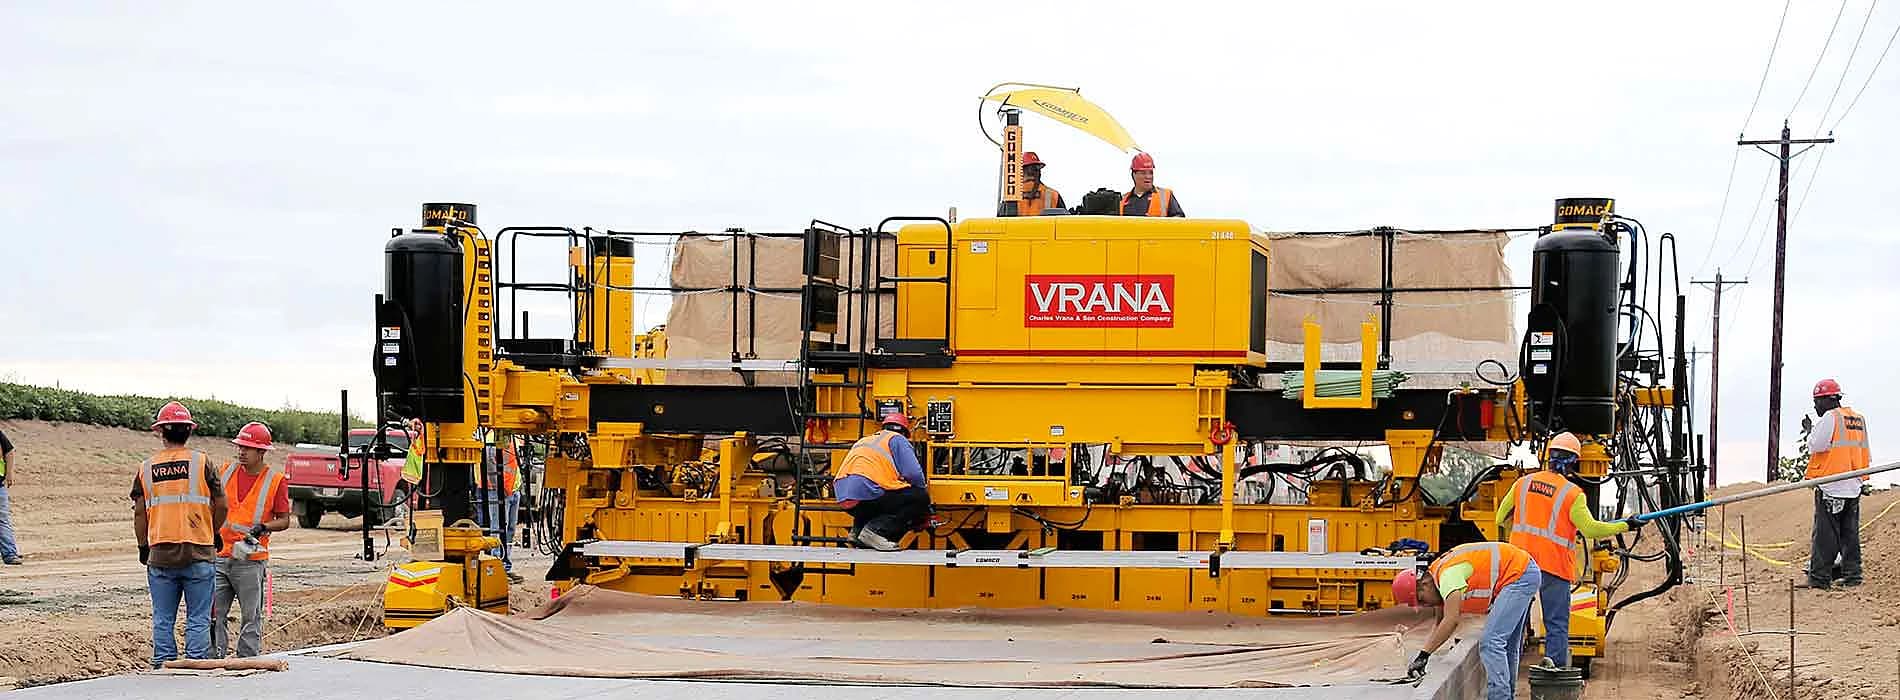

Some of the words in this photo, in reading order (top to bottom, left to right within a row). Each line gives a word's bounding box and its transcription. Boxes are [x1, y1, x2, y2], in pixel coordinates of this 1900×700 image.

[1007, 131, 1016, 195] GOMACO
[1559, 205, 1609, 216] GOMAC
[1030, 283, 1171, 312] VRANA
[153, 465, 188, 477] VRANA
